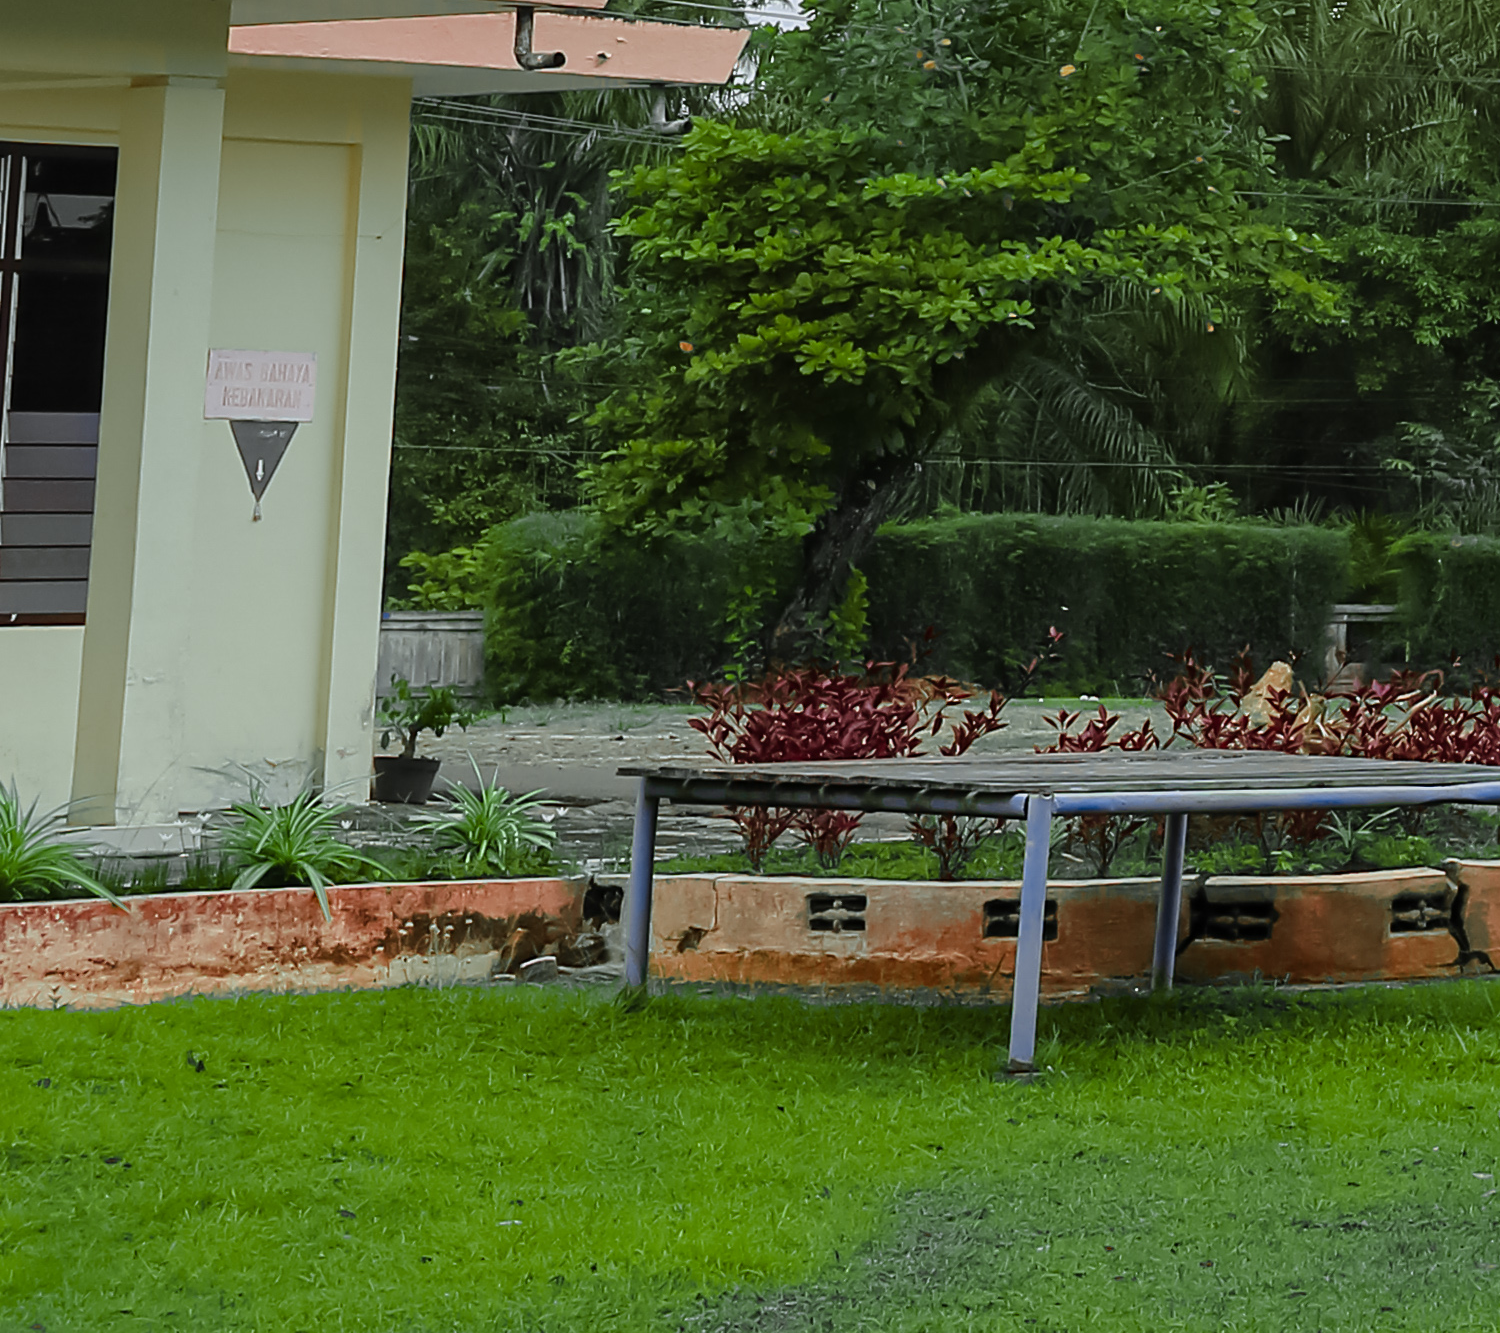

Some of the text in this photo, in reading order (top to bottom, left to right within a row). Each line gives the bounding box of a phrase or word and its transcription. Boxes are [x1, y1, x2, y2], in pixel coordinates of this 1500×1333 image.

[214, 361, 310, 383] AWAS BAHAYA
[222, 386, 302, 408] KEBAKARAN
